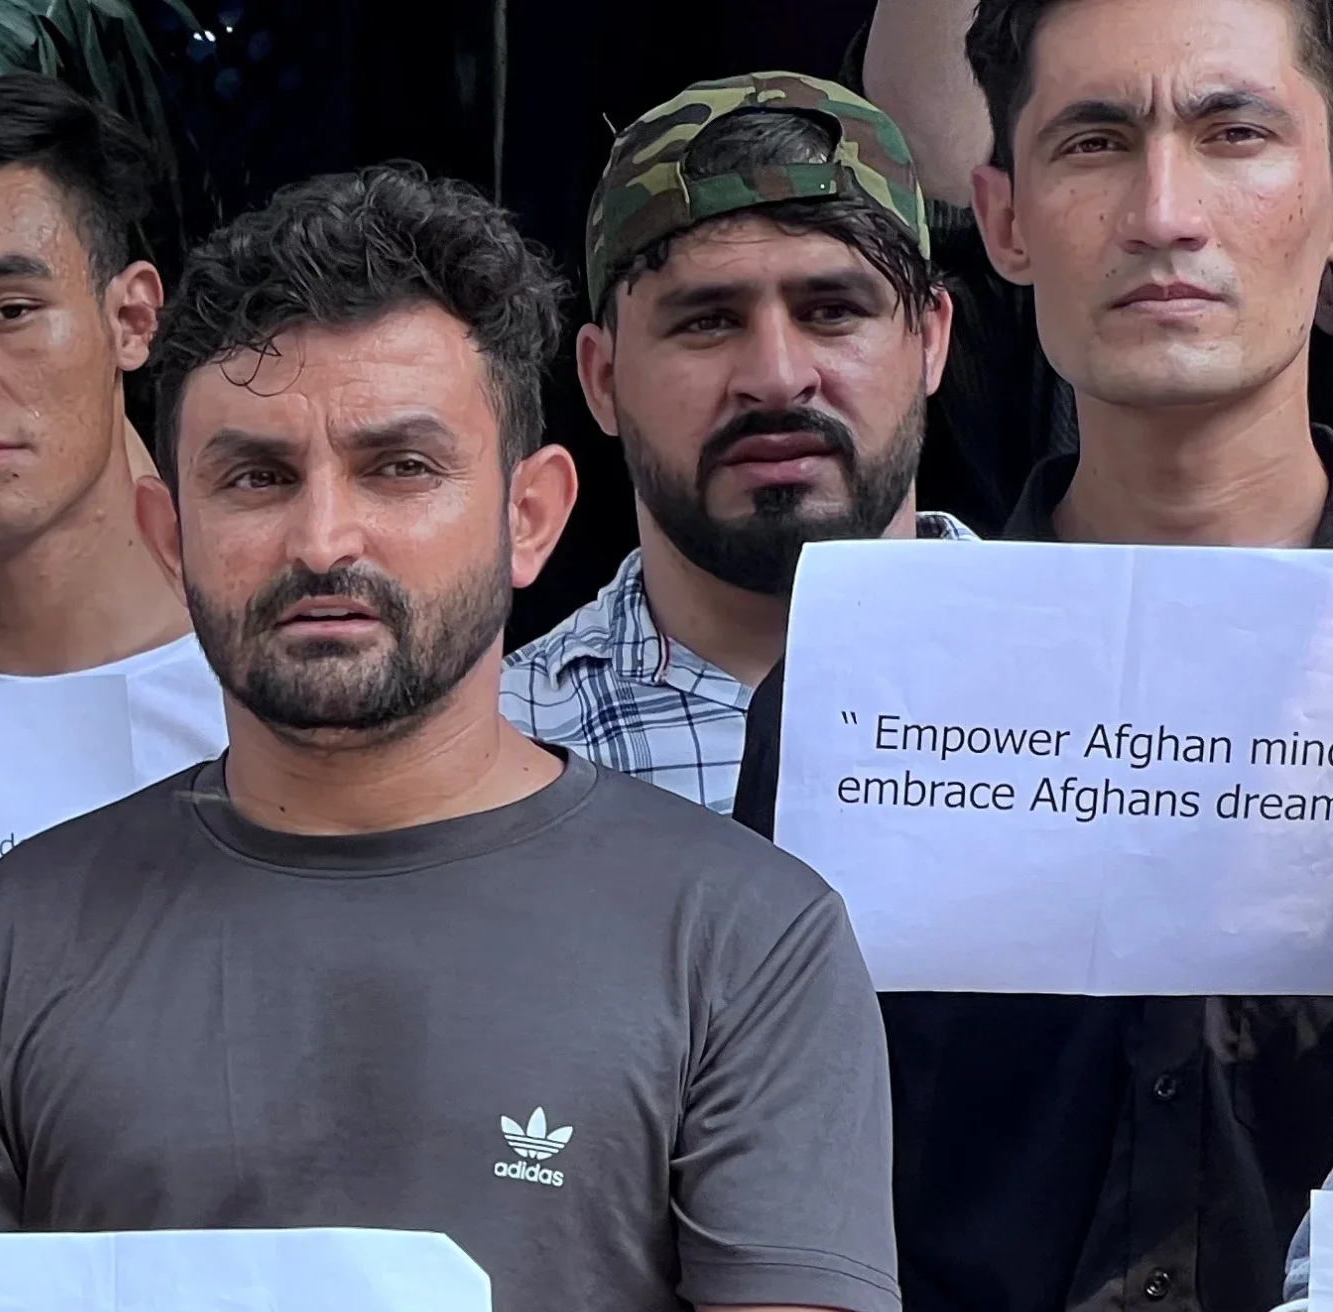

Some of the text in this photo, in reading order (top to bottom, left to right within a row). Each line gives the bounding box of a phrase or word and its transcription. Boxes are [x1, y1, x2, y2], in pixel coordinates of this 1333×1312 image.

[875, 714, 1072, 761] Empower
[1083, 722, 1232, 770] Afghan
[837, 769, 1016, 811] embrace
[1028, 776, 1201, 823] Afghans
[494, 1160, 564, 1187] adidas
